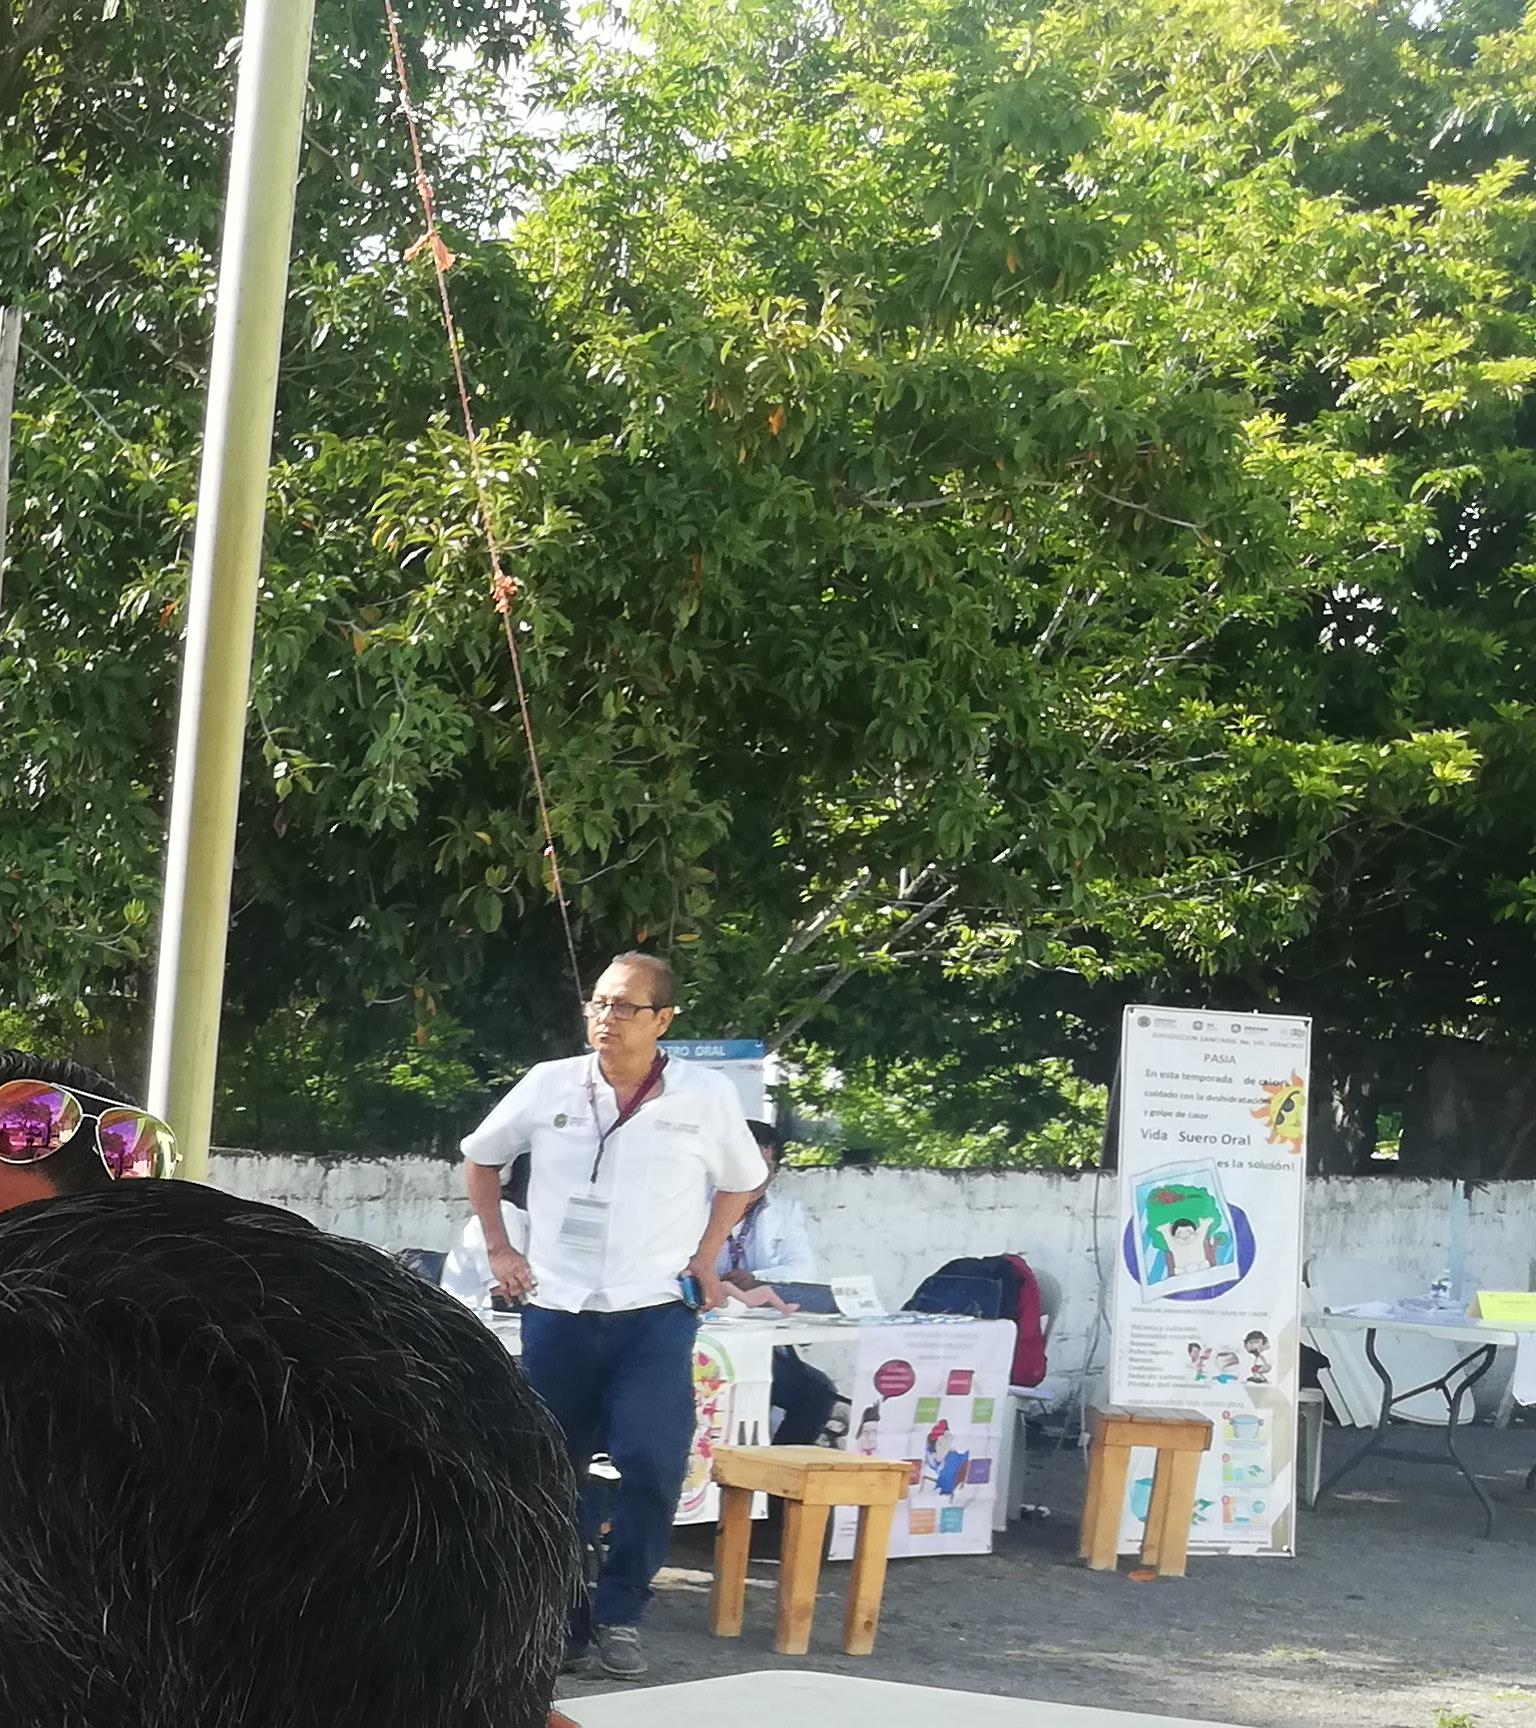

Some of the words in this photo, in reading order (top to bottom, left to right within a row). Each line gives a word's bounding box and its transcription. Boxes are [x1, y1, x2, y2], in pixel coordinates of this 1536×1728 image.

[1203, 1052, 1236, 1064] PASIA
[1145, 1069, 1157, 1078] En
[1160, 1071, 1178, 1080] esta
[1181, 1071, 1233, 1084] temporada
[1243, 1077, 1256, 1086] de
[1141, 1128, 1168, 1141] Vida
[1179, 1131, 1217, 1144] Suero
[1221, 1133, 1251, 1146] Oral
[1217, 1160, 1230, 1169] es
[1232, 1158, 1244, 1169] la
